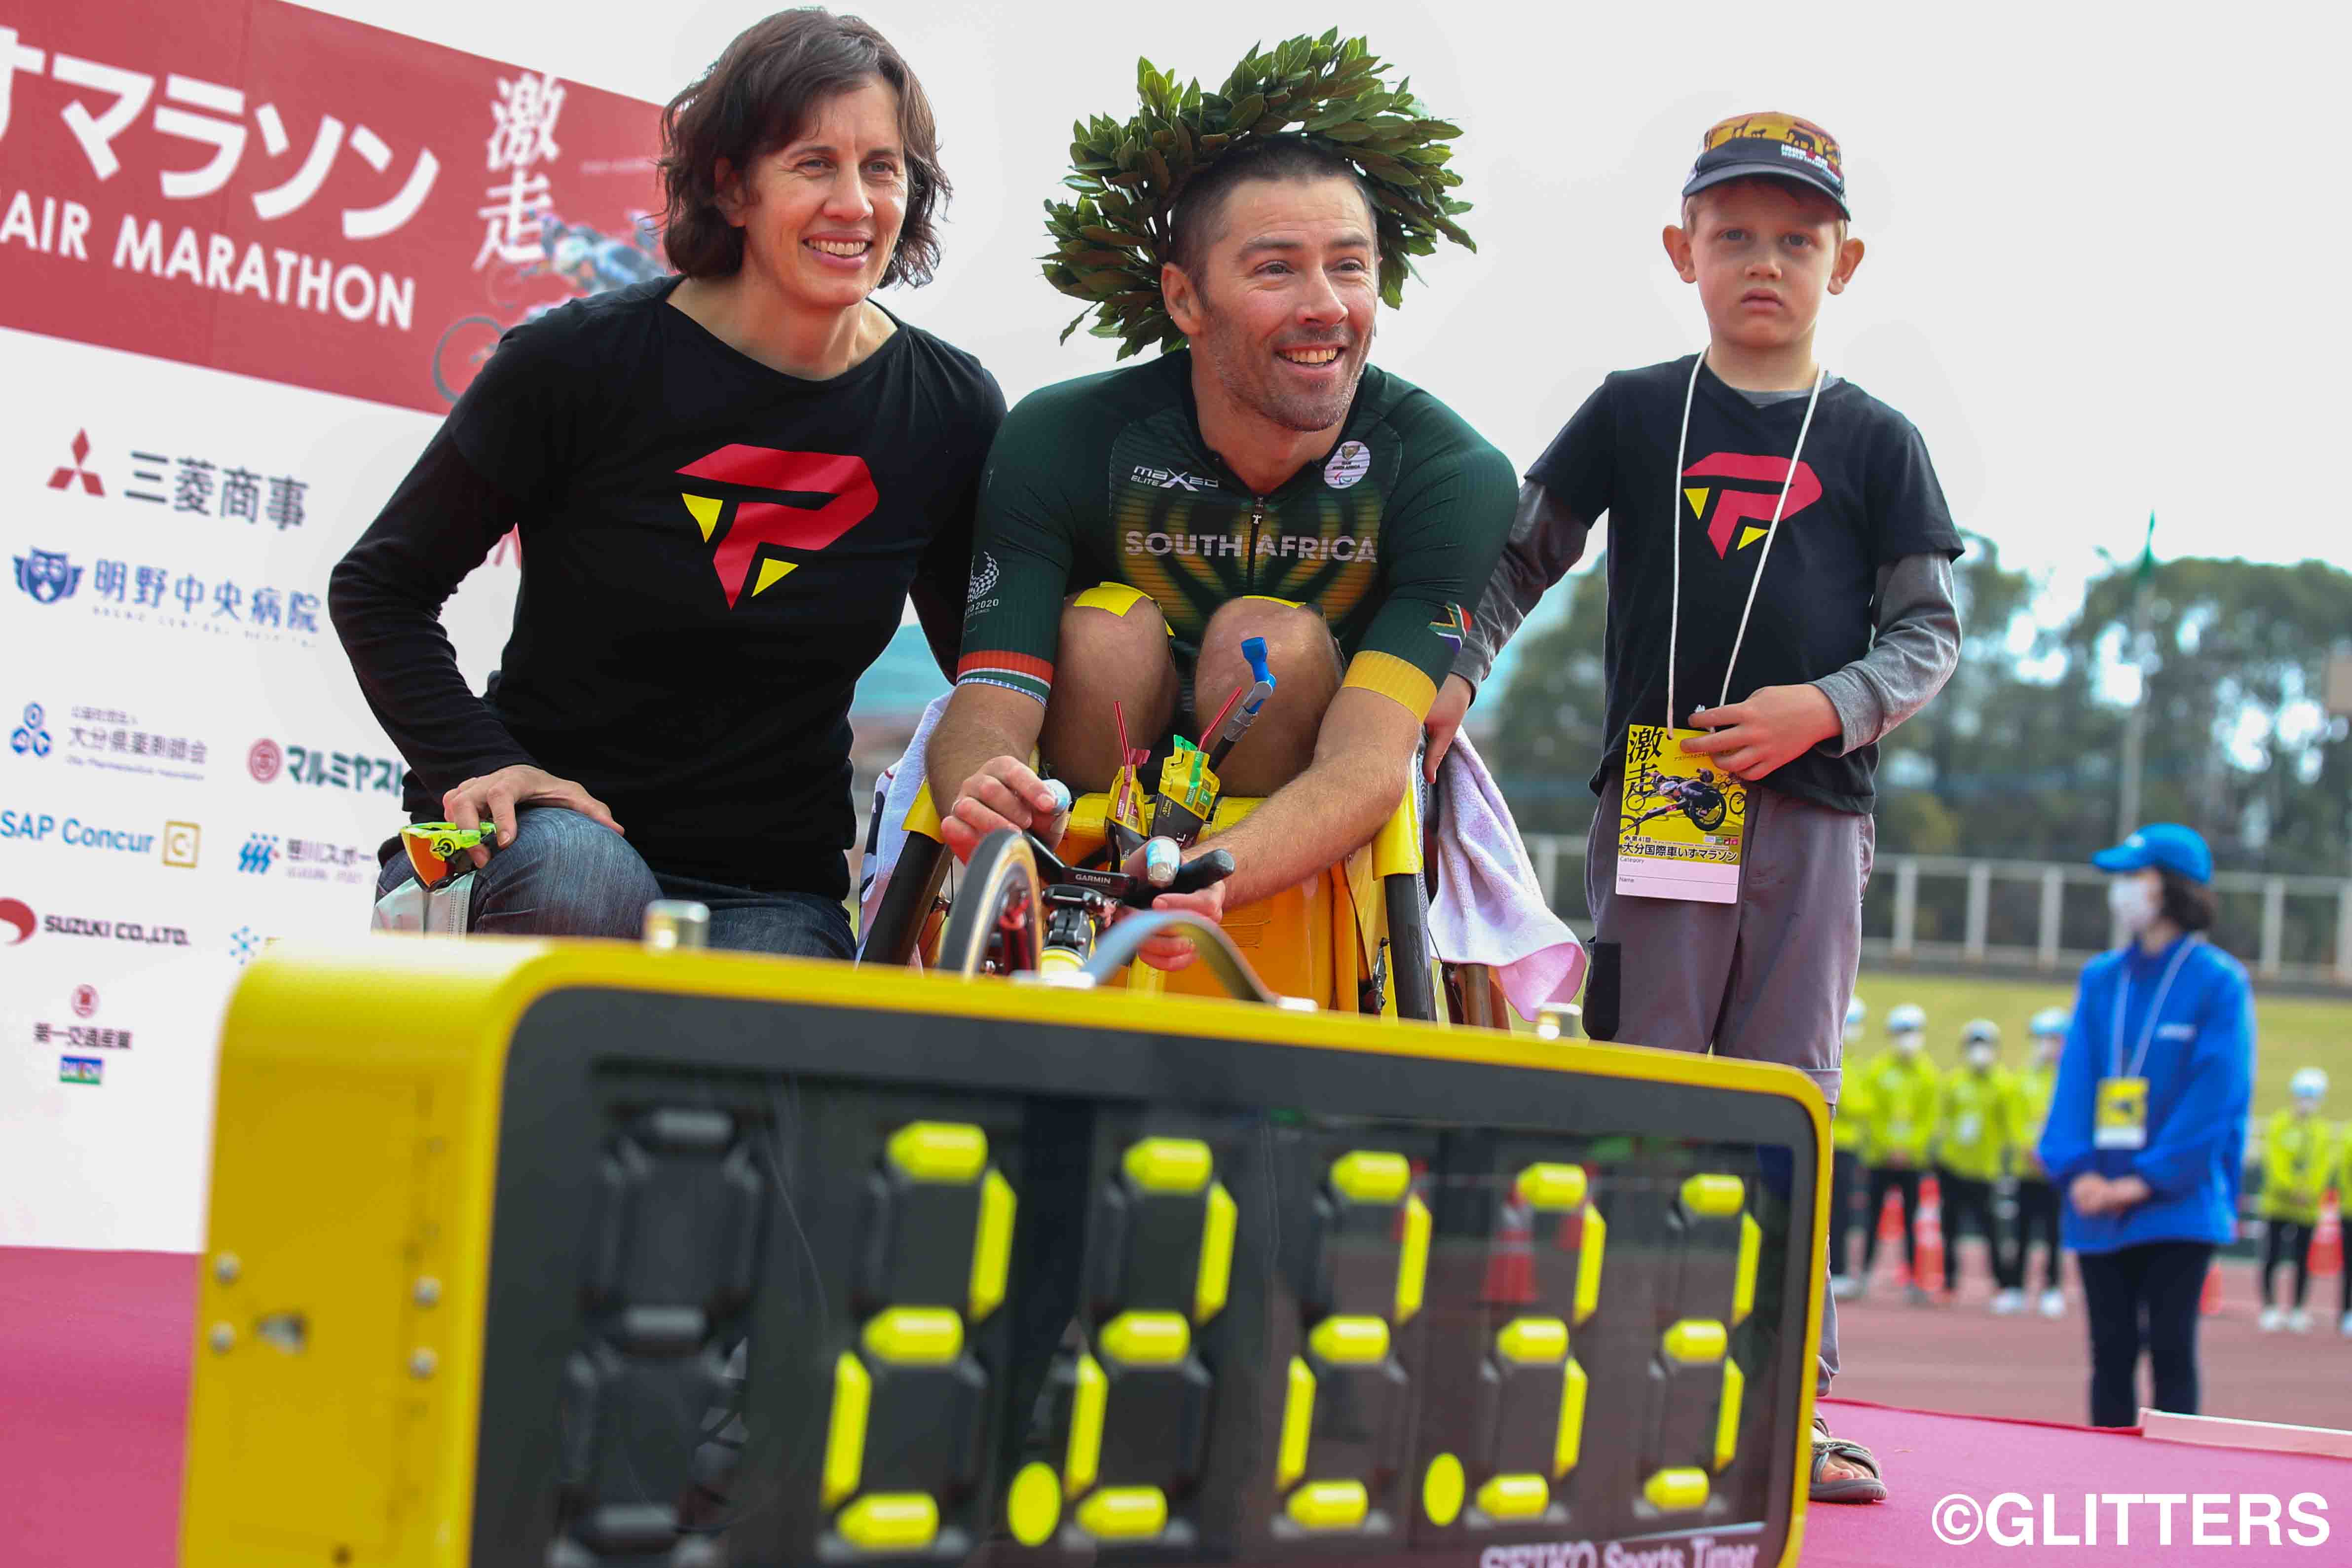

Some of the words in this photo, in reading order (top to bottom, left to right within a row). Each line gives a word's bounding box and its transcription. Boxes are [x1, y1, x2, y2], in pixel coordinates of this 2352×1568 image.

[472, 71, 567, 271] 激走
[113, 214, 416, 332] MARATHON
[124, 449, 310, 530] 三菱商事
[1130, 474, 1159, 486] ELITE
[1124, 530, 1243, 557] SOUTH
[1255, 533, 1378, 563] AFRICA
[94, 558, 321, 634] 明野中央病院
[0, 809, 55, 840] SAP
[62, 817, 155, 854] Concur
[1619, 856, 1645, 864] Category
[1623, 843, 1738, 861] 大分国際車いすマラソン
[1075, 873, 1111, 884] GARMIN
[44, 914, 112, 938] SUZUKI
